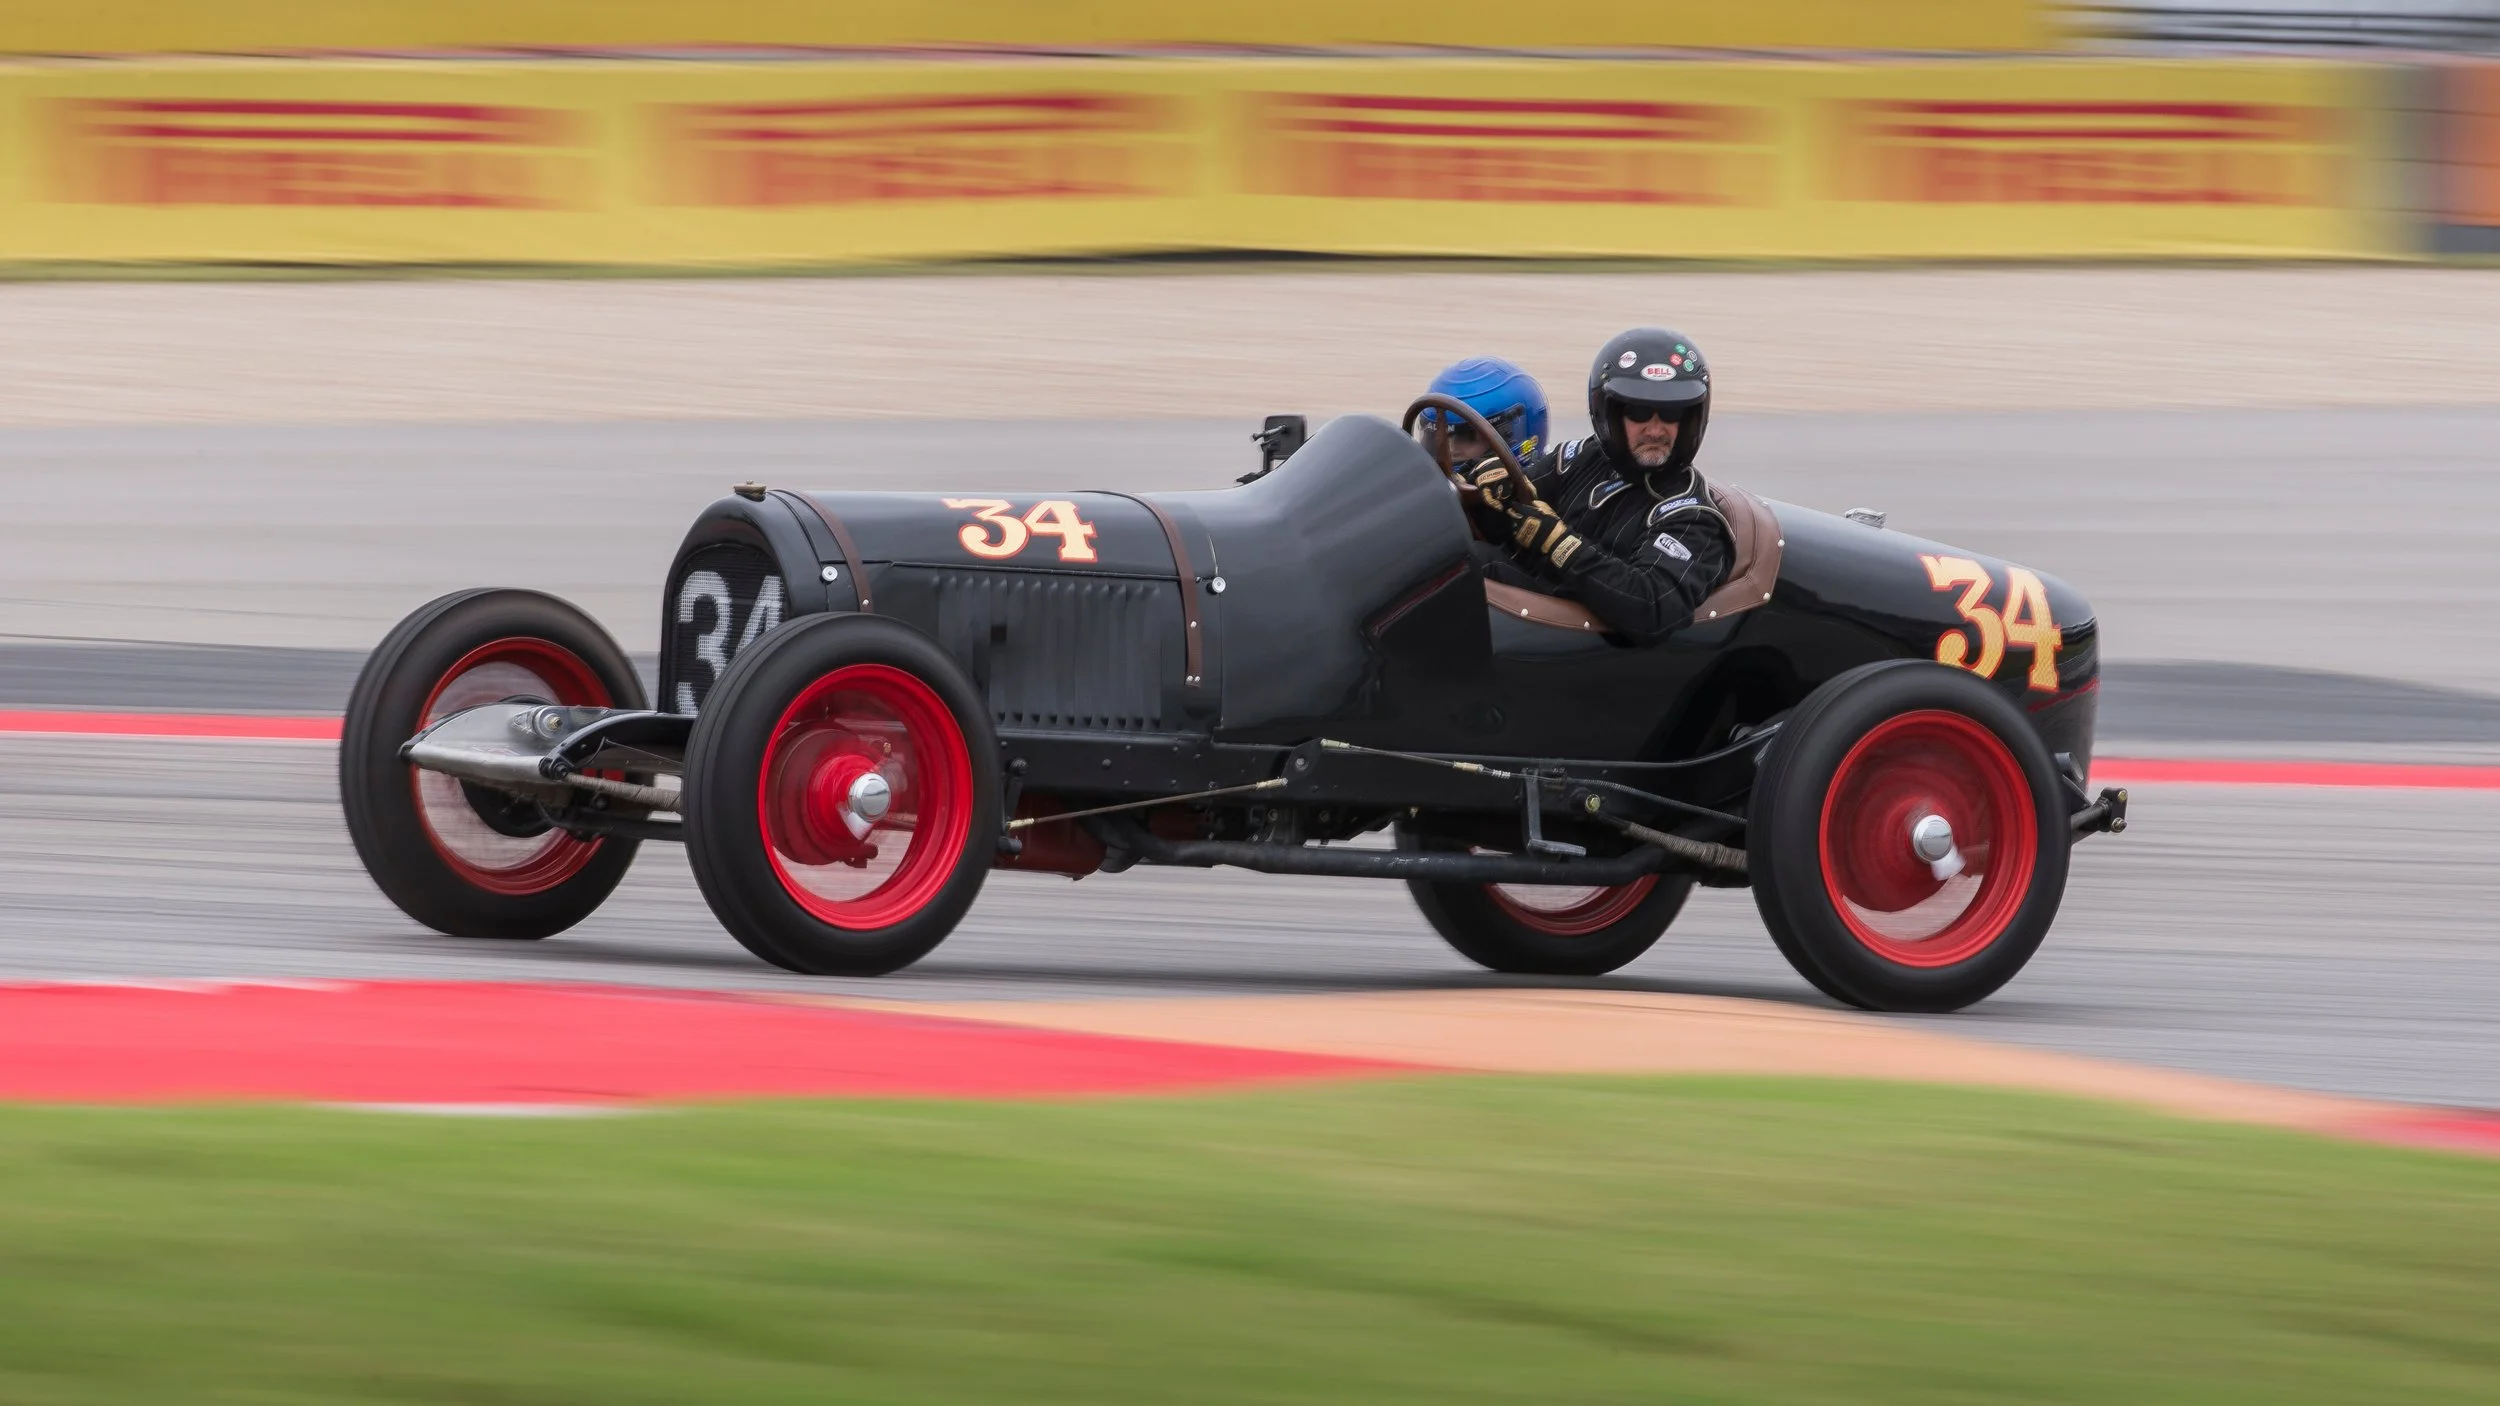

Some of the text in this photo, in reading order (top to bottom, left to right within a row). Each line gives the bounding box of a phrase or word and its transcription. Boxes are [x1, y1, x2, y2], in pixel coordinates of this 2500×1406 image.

[1647, 367, 1672, 375] BELL
[941, 498, 1098, 563] 34
[1916, 553, 2063, 693] 34
